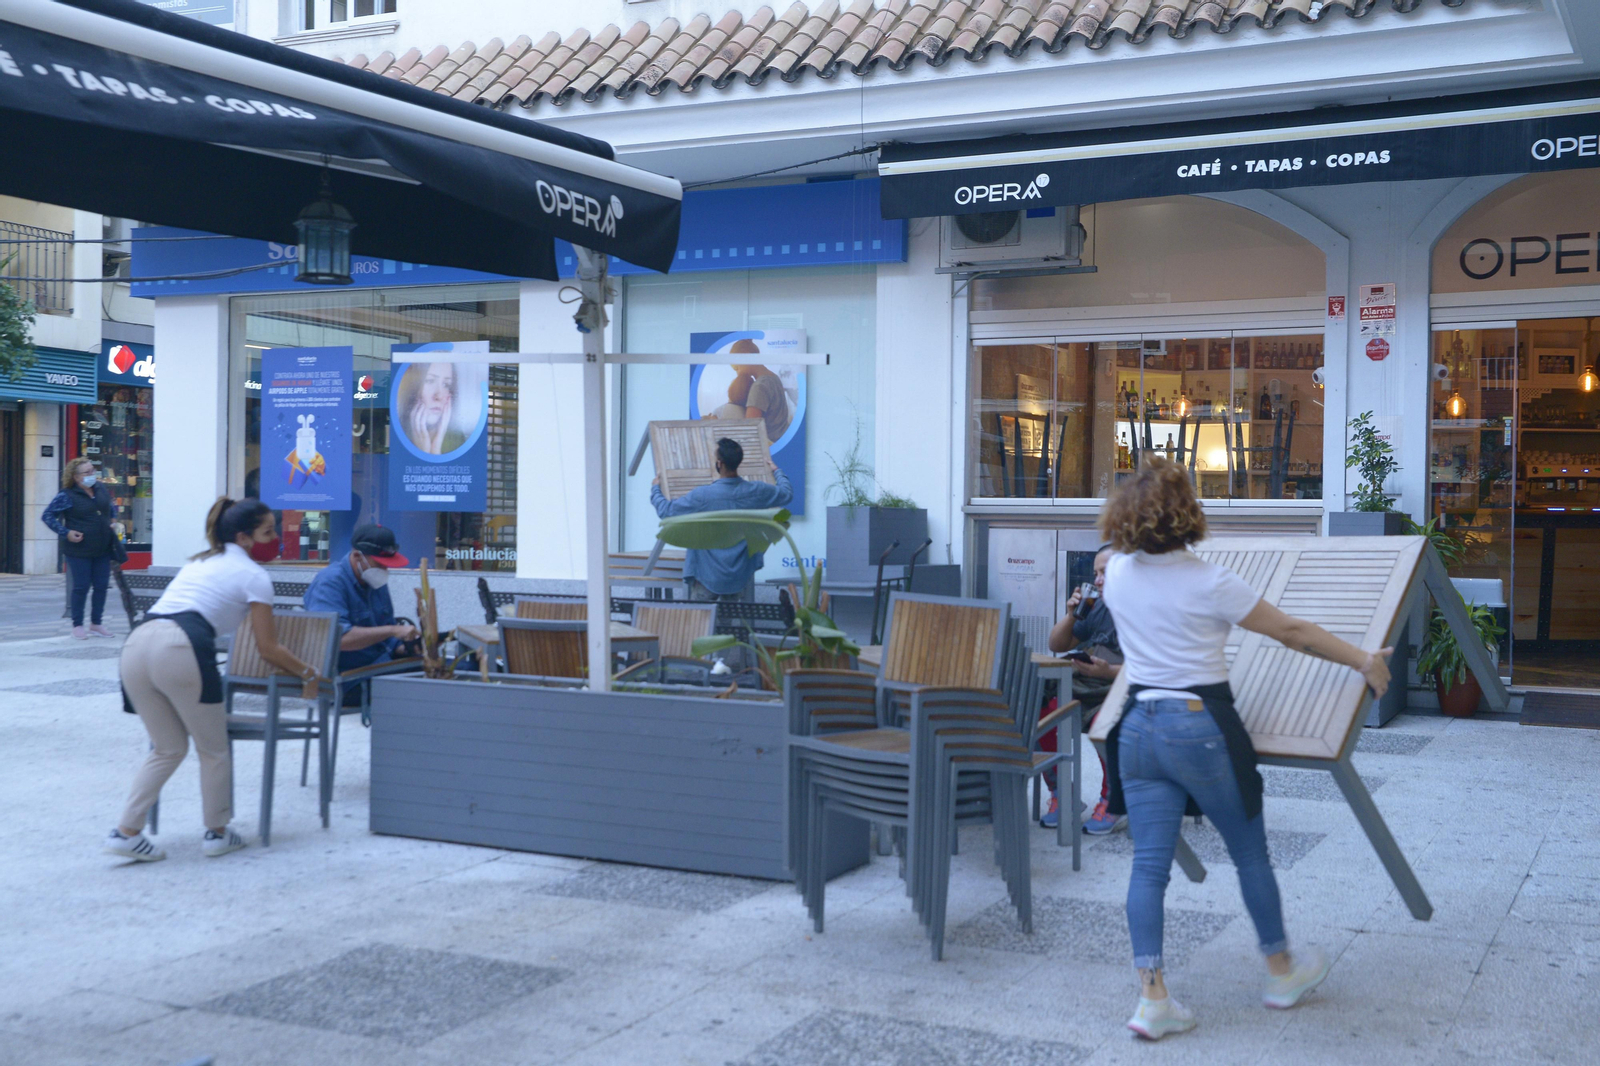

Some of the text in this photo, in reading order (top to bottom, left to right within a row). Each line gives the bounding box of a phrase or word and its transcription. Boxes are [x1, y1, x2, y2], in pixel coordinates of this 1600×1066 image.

[51, 63, 178, 104] TAPAS
[204, 94, 317, 120] COPAS
[1531, 135, 1600, 160] OPE
[1176, 150, 1391, 178] CAFÉ TAPAS COPAS
[954, 181, 1042, 205] OPERA
[535, 179, 616, 238] OPERA
[1460, 231, 1600, 280] OPE
[45, 373, 78, 386] YAVEO
